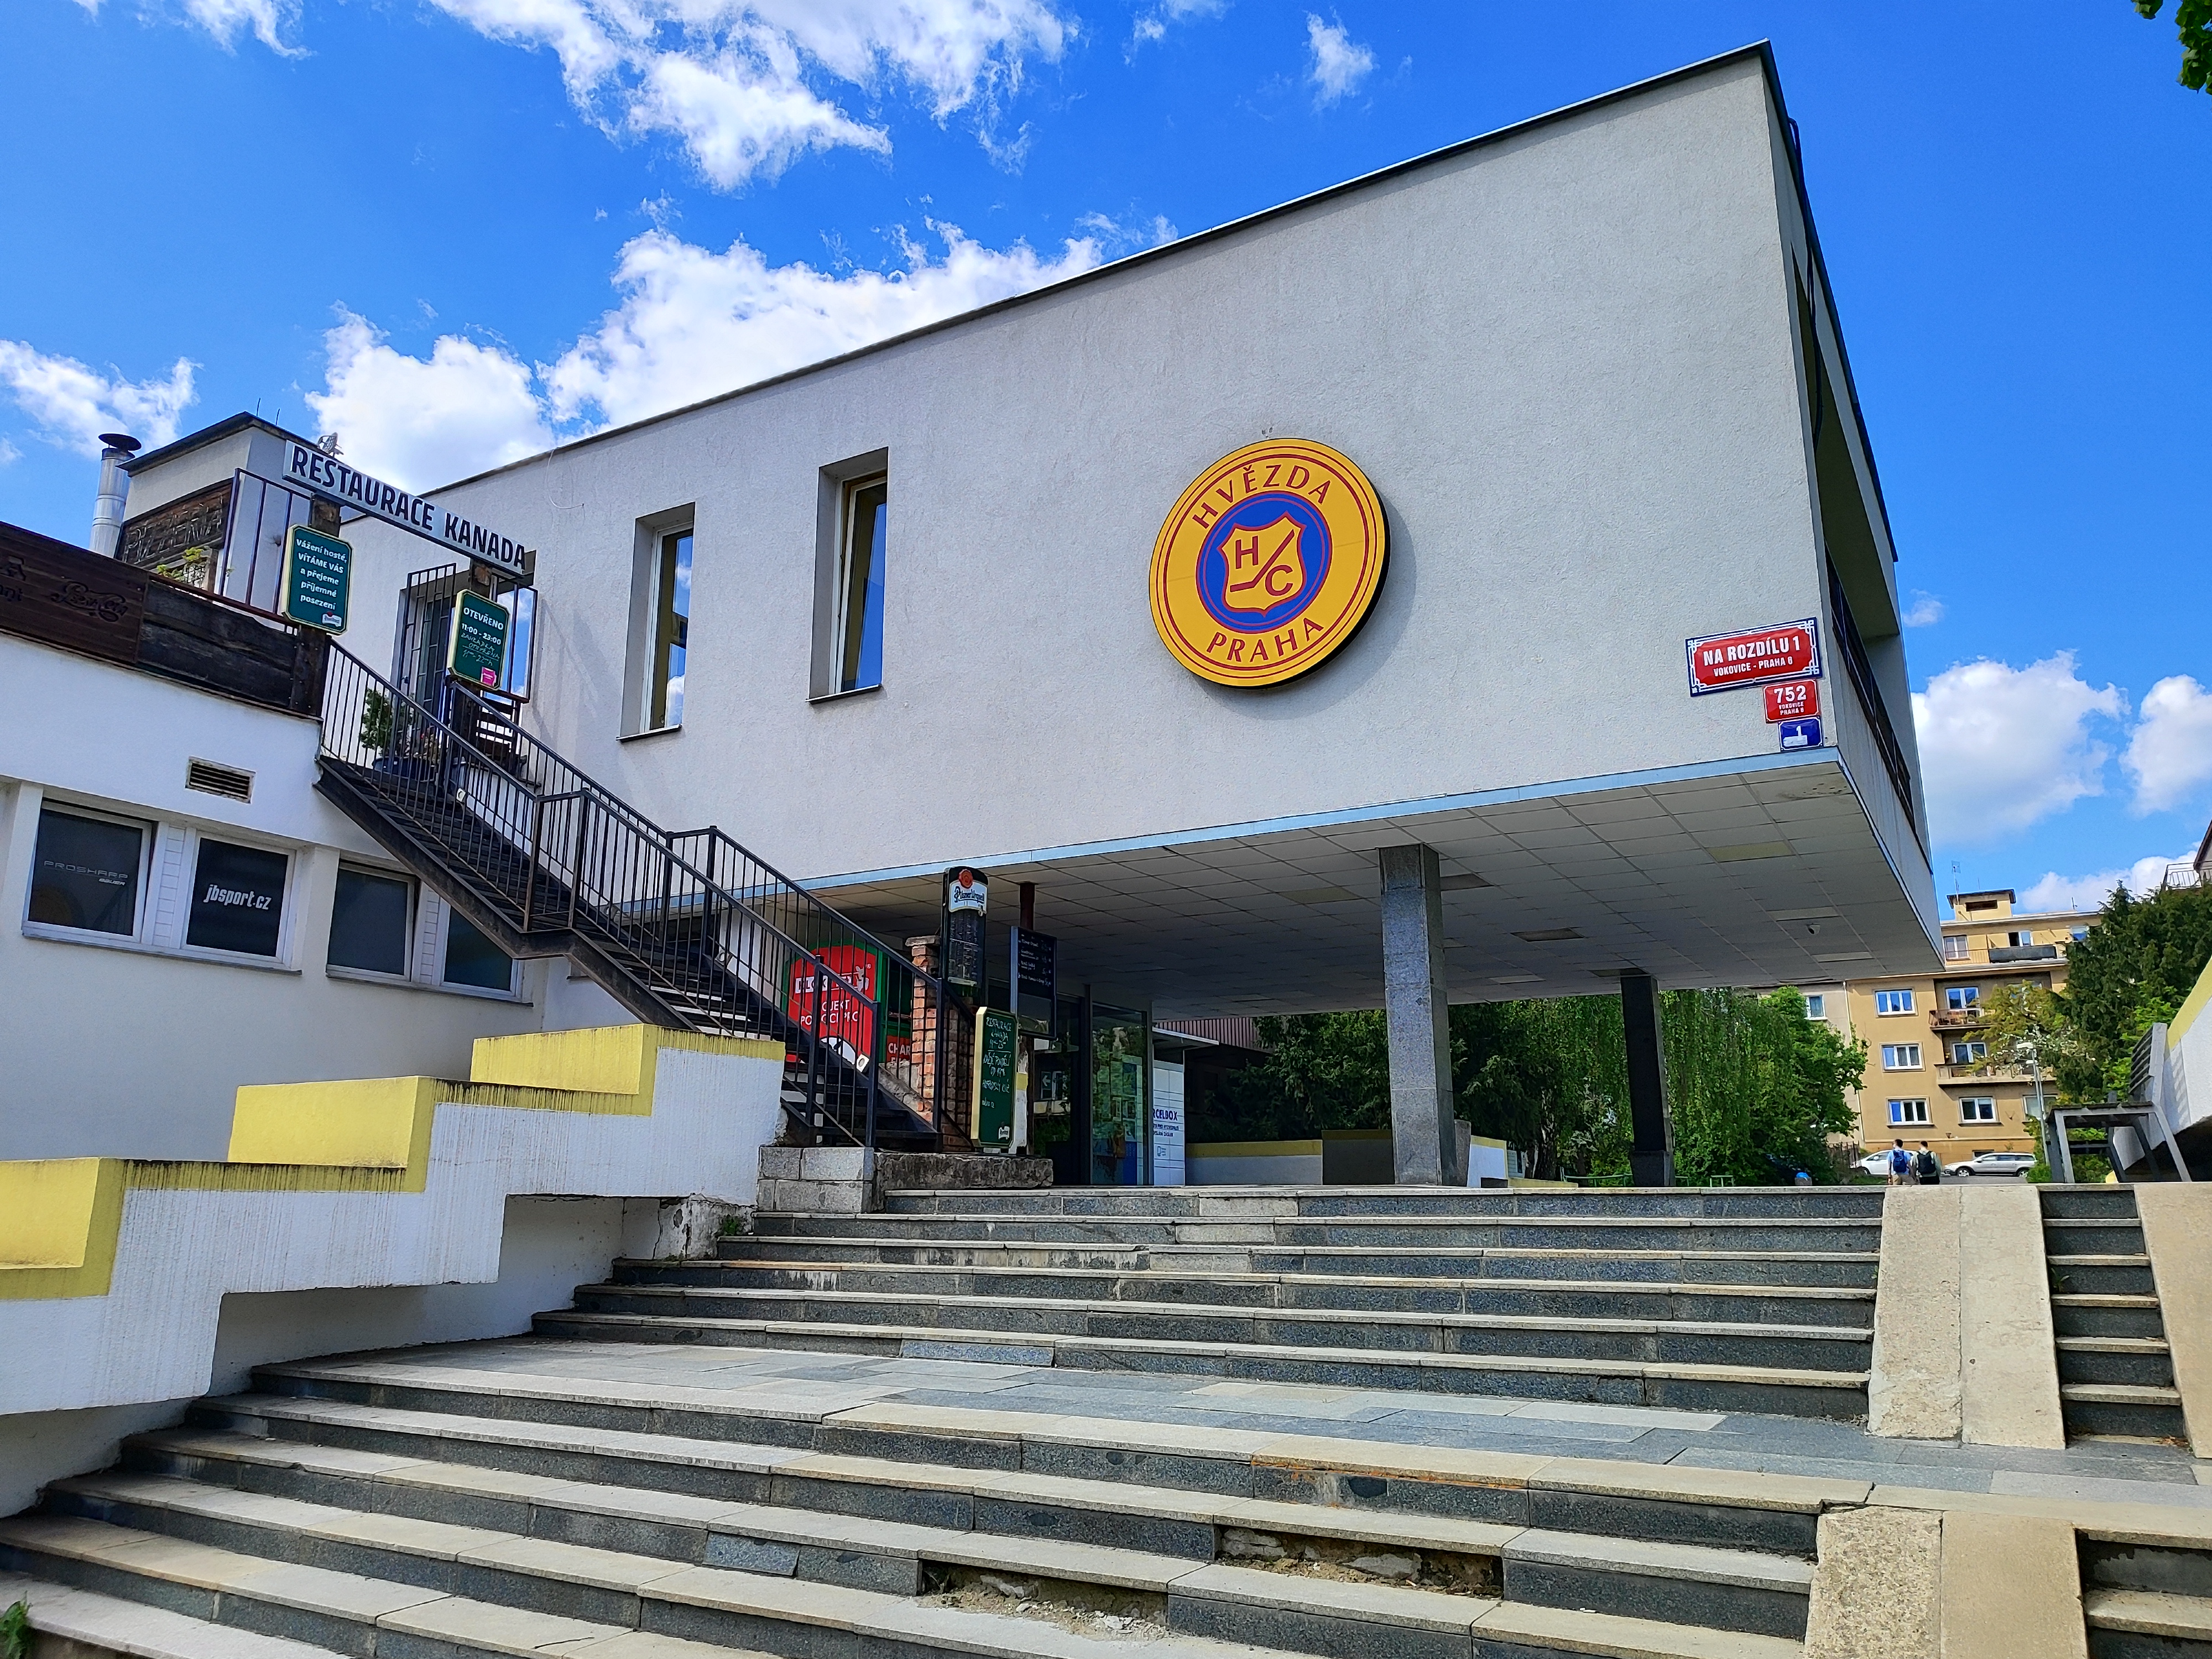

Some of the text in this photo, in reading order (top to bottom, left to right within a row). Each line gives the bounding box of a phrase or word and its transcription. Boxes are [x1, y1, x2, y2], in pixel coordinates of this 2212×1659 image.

[1192, 463, 1331, 530] HVĚZDA
[290, 445, 526, 570] RESTAURACE KANADA
[296, 539, 347, 564] Vážení hosté,
[298, 552, 344, 573] VÍTÁME VÁS
[307, 570, 339, 585] přejeme
[301, 581, 337, 597] příjemné
[300, 594, 336, 610] posezení
[463, 607, 504, 630] OTEVŘENO
[462, 623, 478, 635] 11:00
[483, 633, 501, 645] 23:00
[1206, 617, 1324, 663] PRAHA
[1703, 635, 1801, 666] NA ROZDÍLU 1
[1713, 663, 1751, 677] VOKOVICE
[1759, 658, 1786, 670] PRAHA
[1774, 685, 1807, 703] 752
[1778, 701, 1804, 709] VOKOVICE
[44, 860, 128, 879] PROSHARP
[203, 884, 272, 910] jbsport.cz
[954, 886, 972, 903] Pilsner
